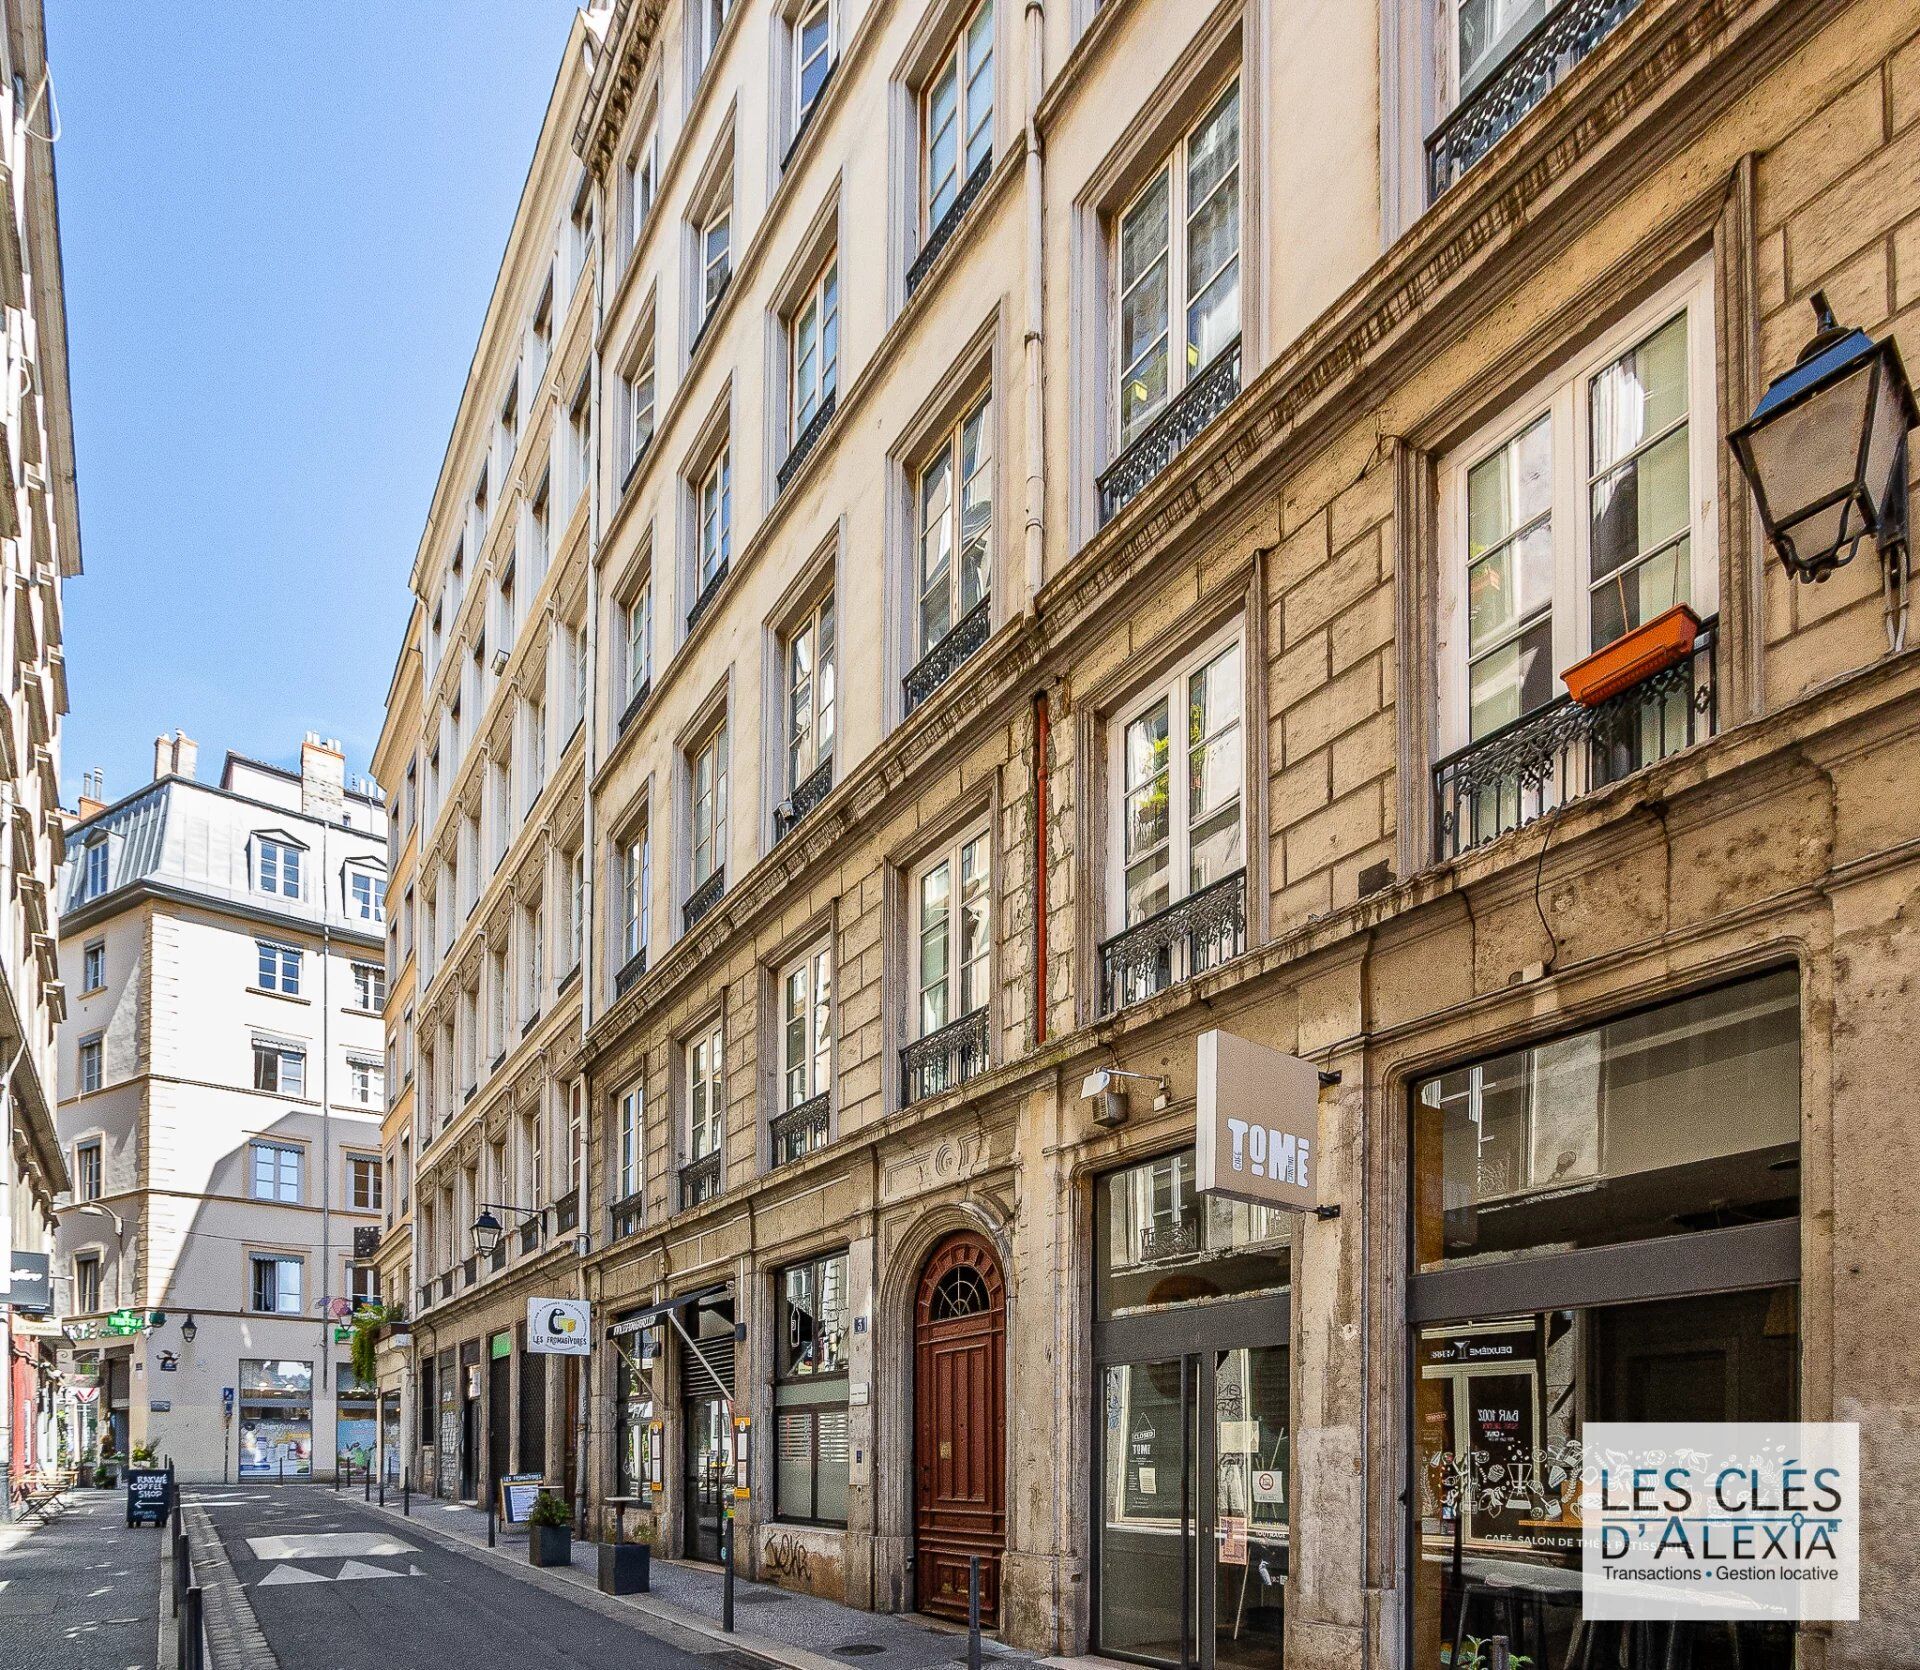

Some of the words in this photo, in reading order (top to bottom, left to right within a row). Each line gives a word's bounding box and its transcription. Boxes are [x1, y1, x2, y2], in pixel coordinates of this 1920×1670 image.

[533, 1336, 543, 1345] LES
[1518, 1535, 1555, 1546] SALON
[1558, 1538, 1573, 1547] DE
[1576, 1537, 1600, 1549] THÉ
